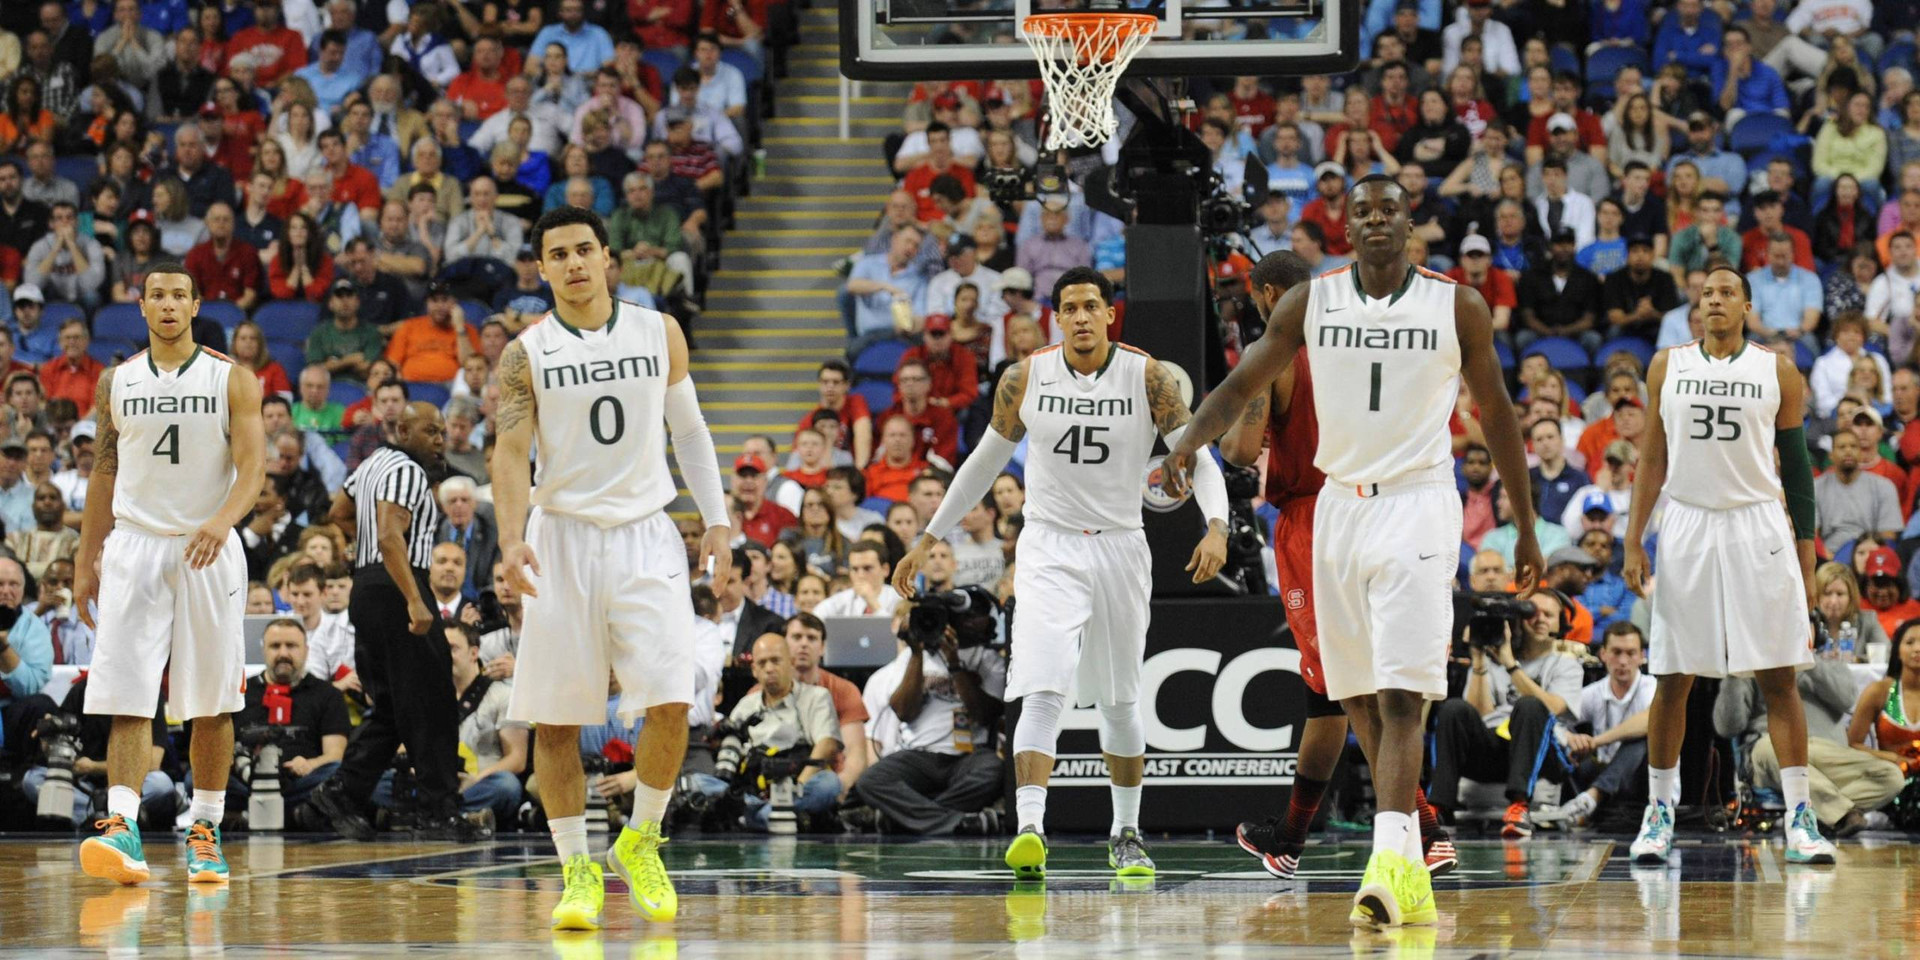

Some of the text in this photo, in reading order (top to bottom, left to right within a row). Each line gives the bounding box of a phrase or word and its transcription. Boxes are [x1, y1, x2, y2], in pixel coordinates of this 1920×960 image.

[1369, 362, 1382, 412] 1
[589, 395, 625, 446] 0
[1690, 404, 1742, 442] 35
[152, 424, 180, 465] 4
[1052, 424, 1110, 465] 45
[1142, 759, 1182, 776] AST
[1184, 759, 1298, 776] CONFERENC
